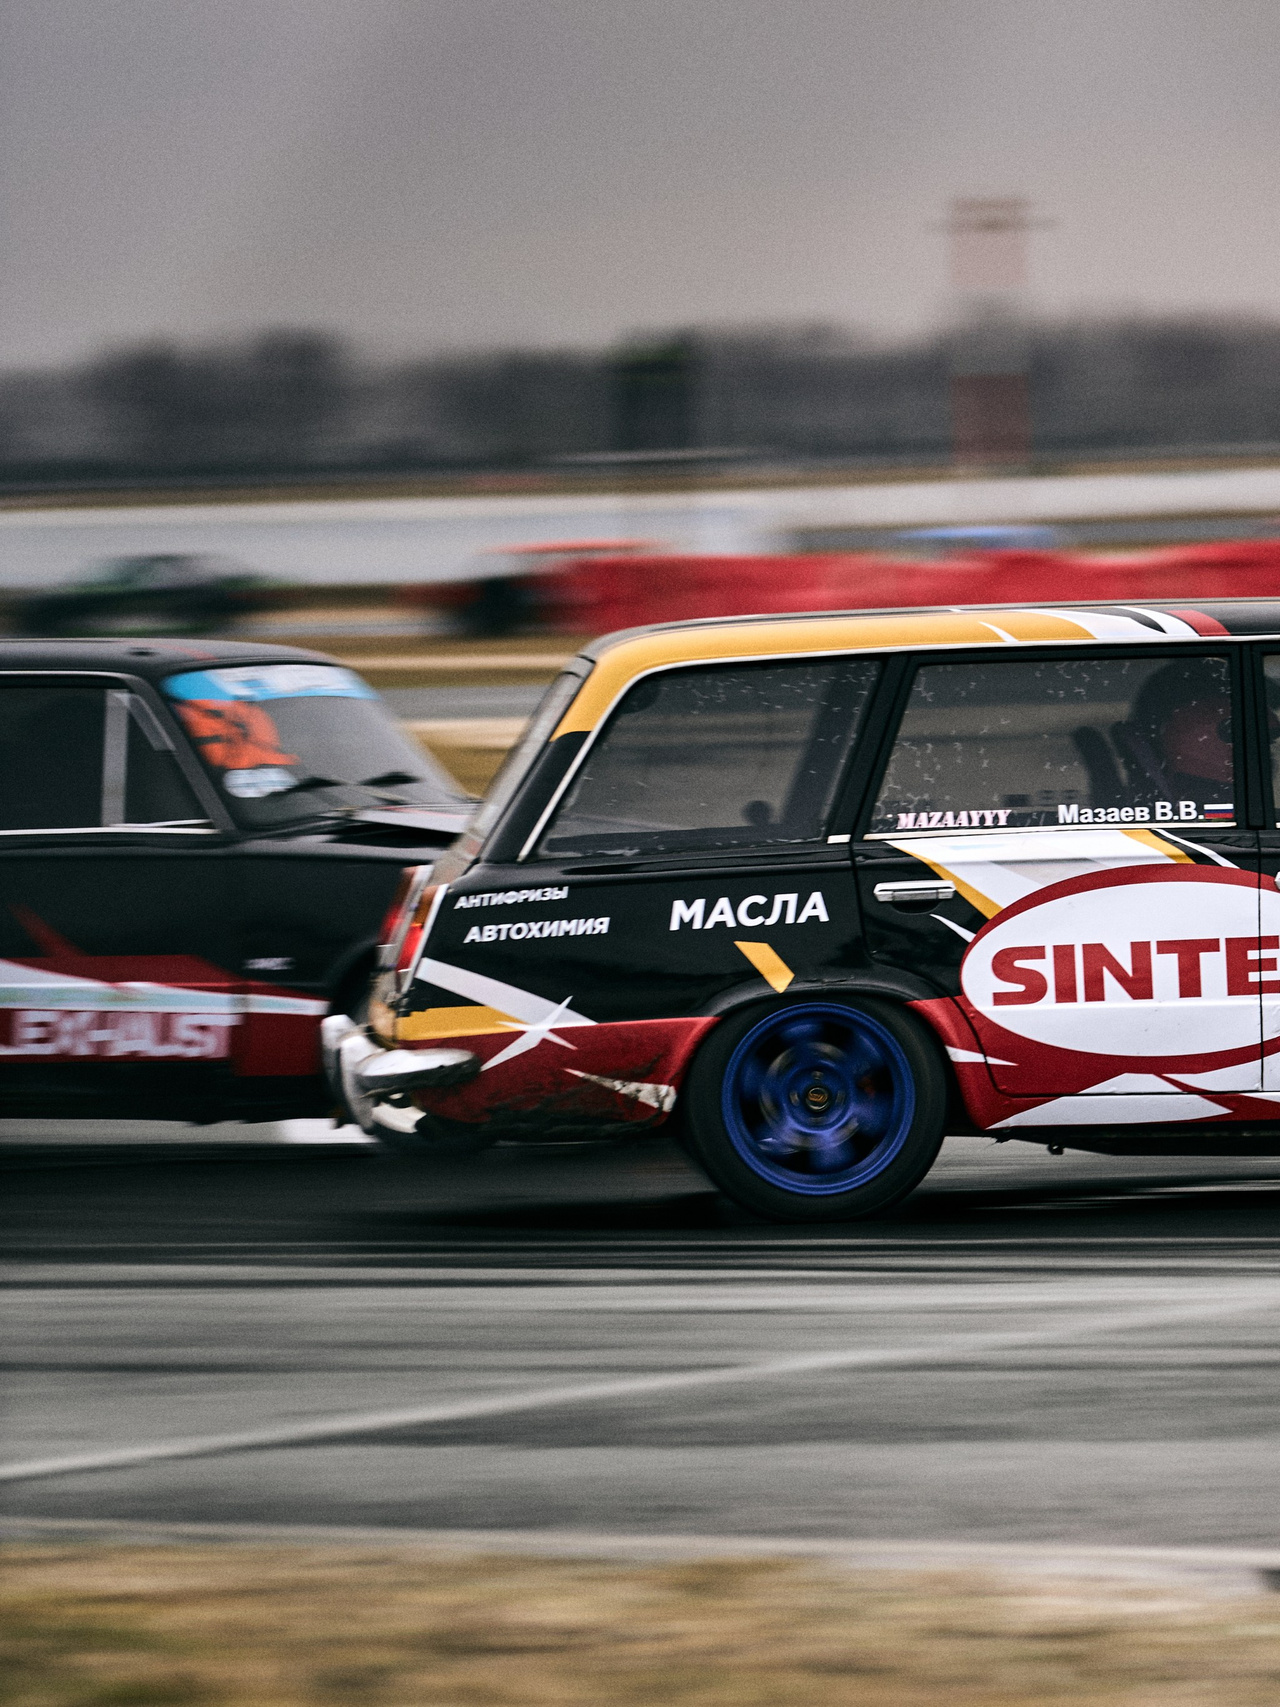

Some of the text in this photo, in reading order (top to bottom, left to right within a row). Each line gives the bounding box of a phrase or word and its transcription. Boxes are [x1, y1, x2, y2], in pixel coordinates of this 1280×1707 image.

[896, 810, 1012, 829] MAZAAYYY
[1058, 801, 1204, 824] Мазаев В.В.
[454, 886, 569, 909] АНТИФРИЗЫ
[669, 891, 829, 931] МАСЛА
[463, 917, 610, 944] АВТОХИМИЯ
